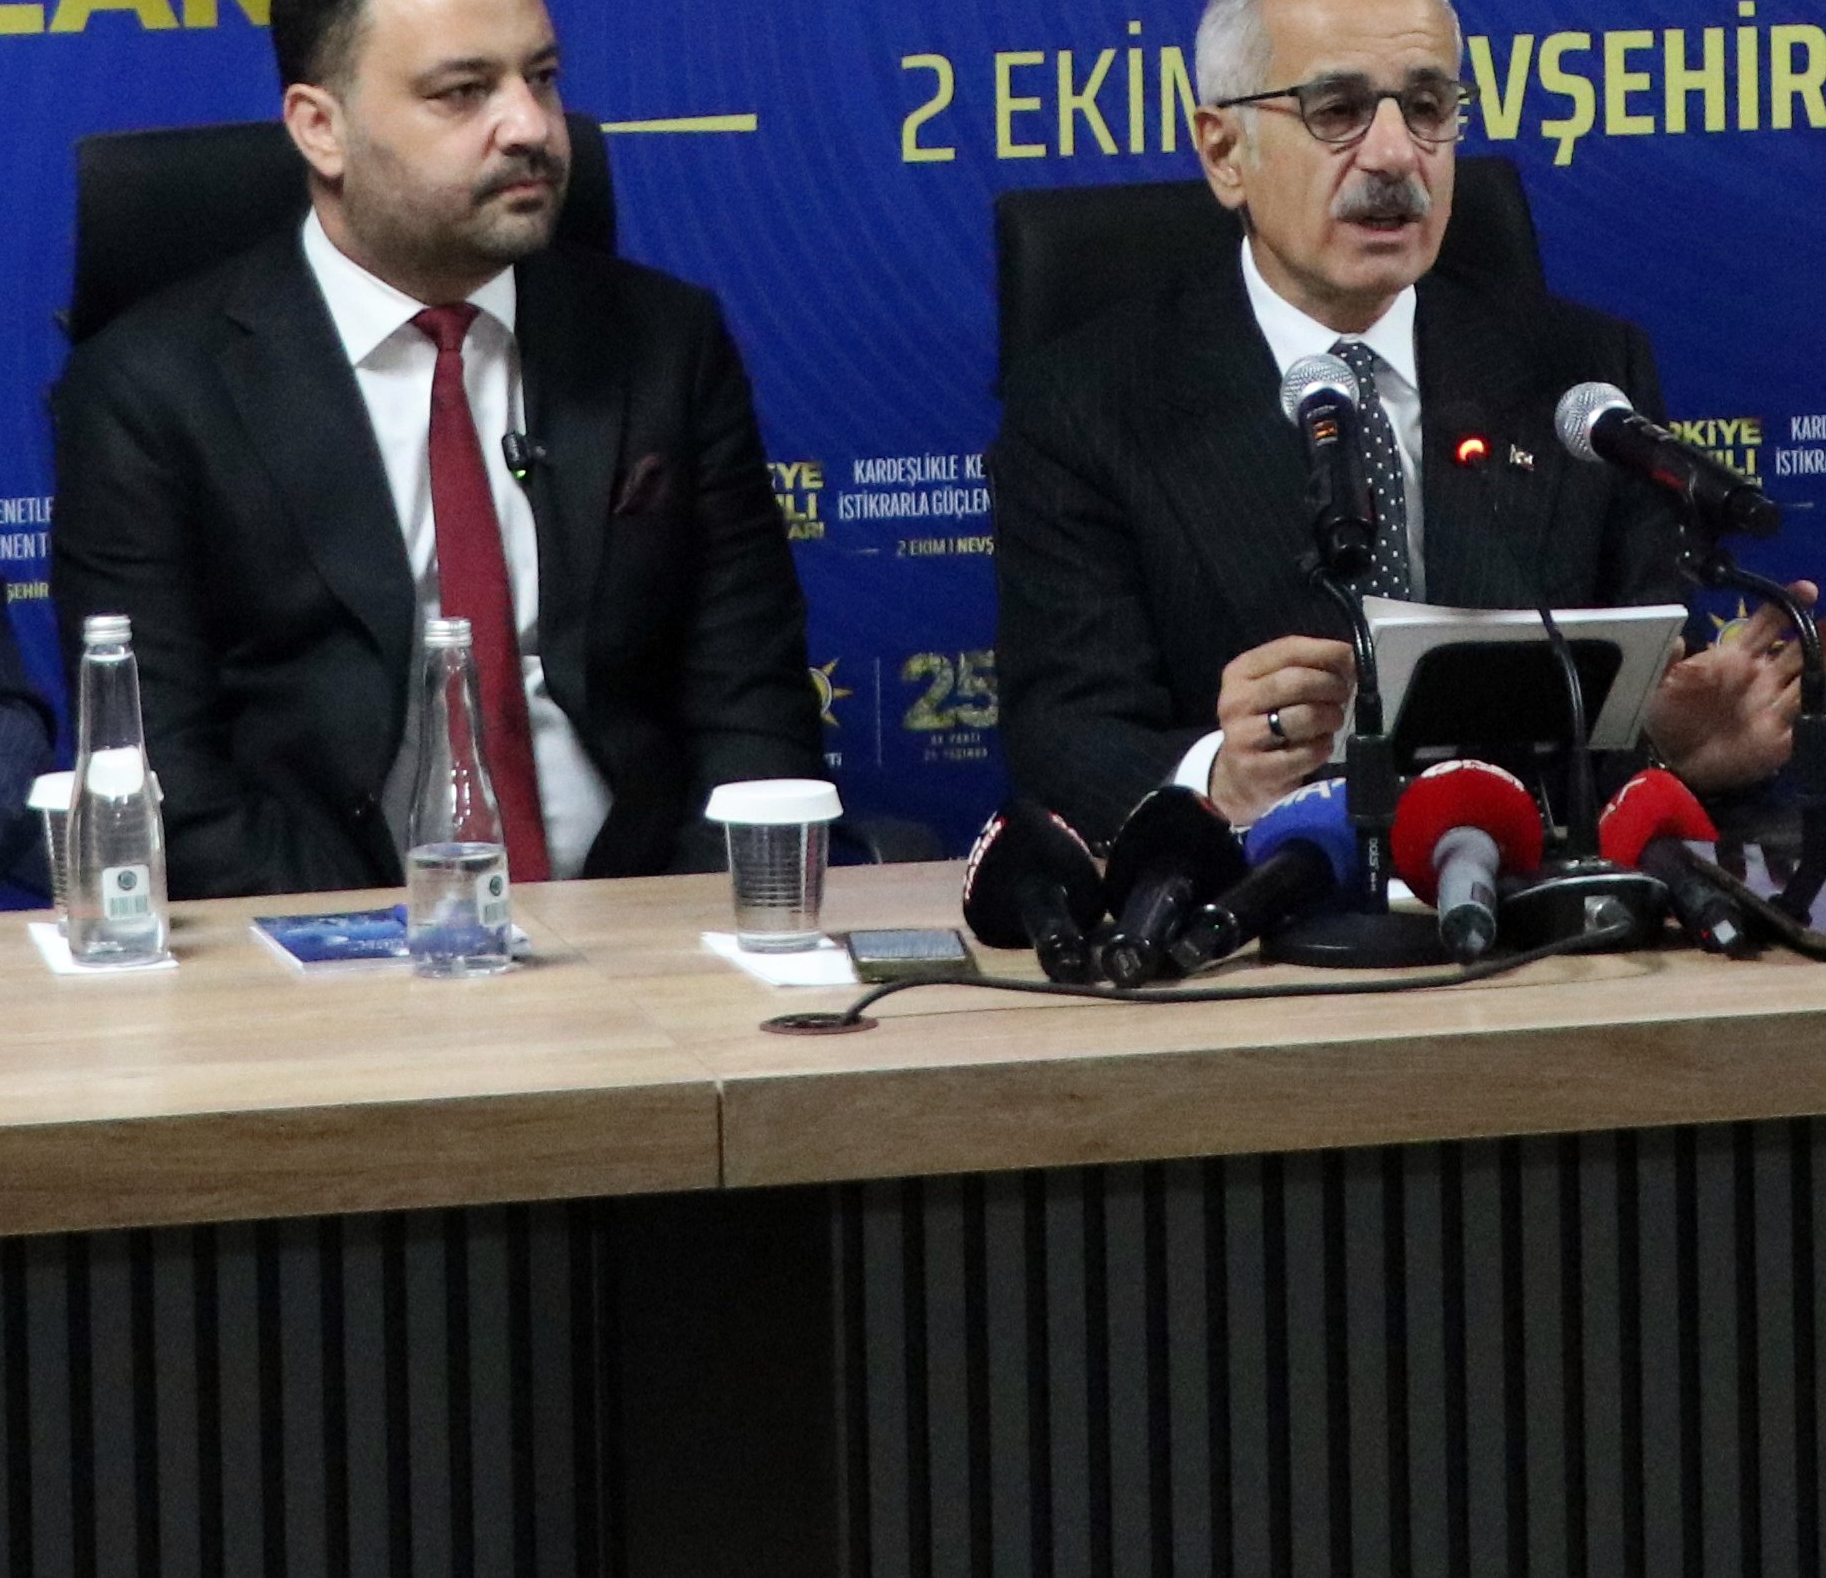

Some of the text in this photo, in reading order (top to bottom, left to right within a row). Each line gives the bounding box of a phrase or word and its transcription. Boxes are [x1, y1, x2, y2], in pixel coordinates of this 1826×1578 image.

[901, 53, 955, 162] 2
[854, 452, 958, 486] KARDEŞLİKLE
[838, 489, 930, 520] İSTİKRARLA
[931, 485, 992, 519] GÜÇLEN
[901, 650, 999, 731] 25
